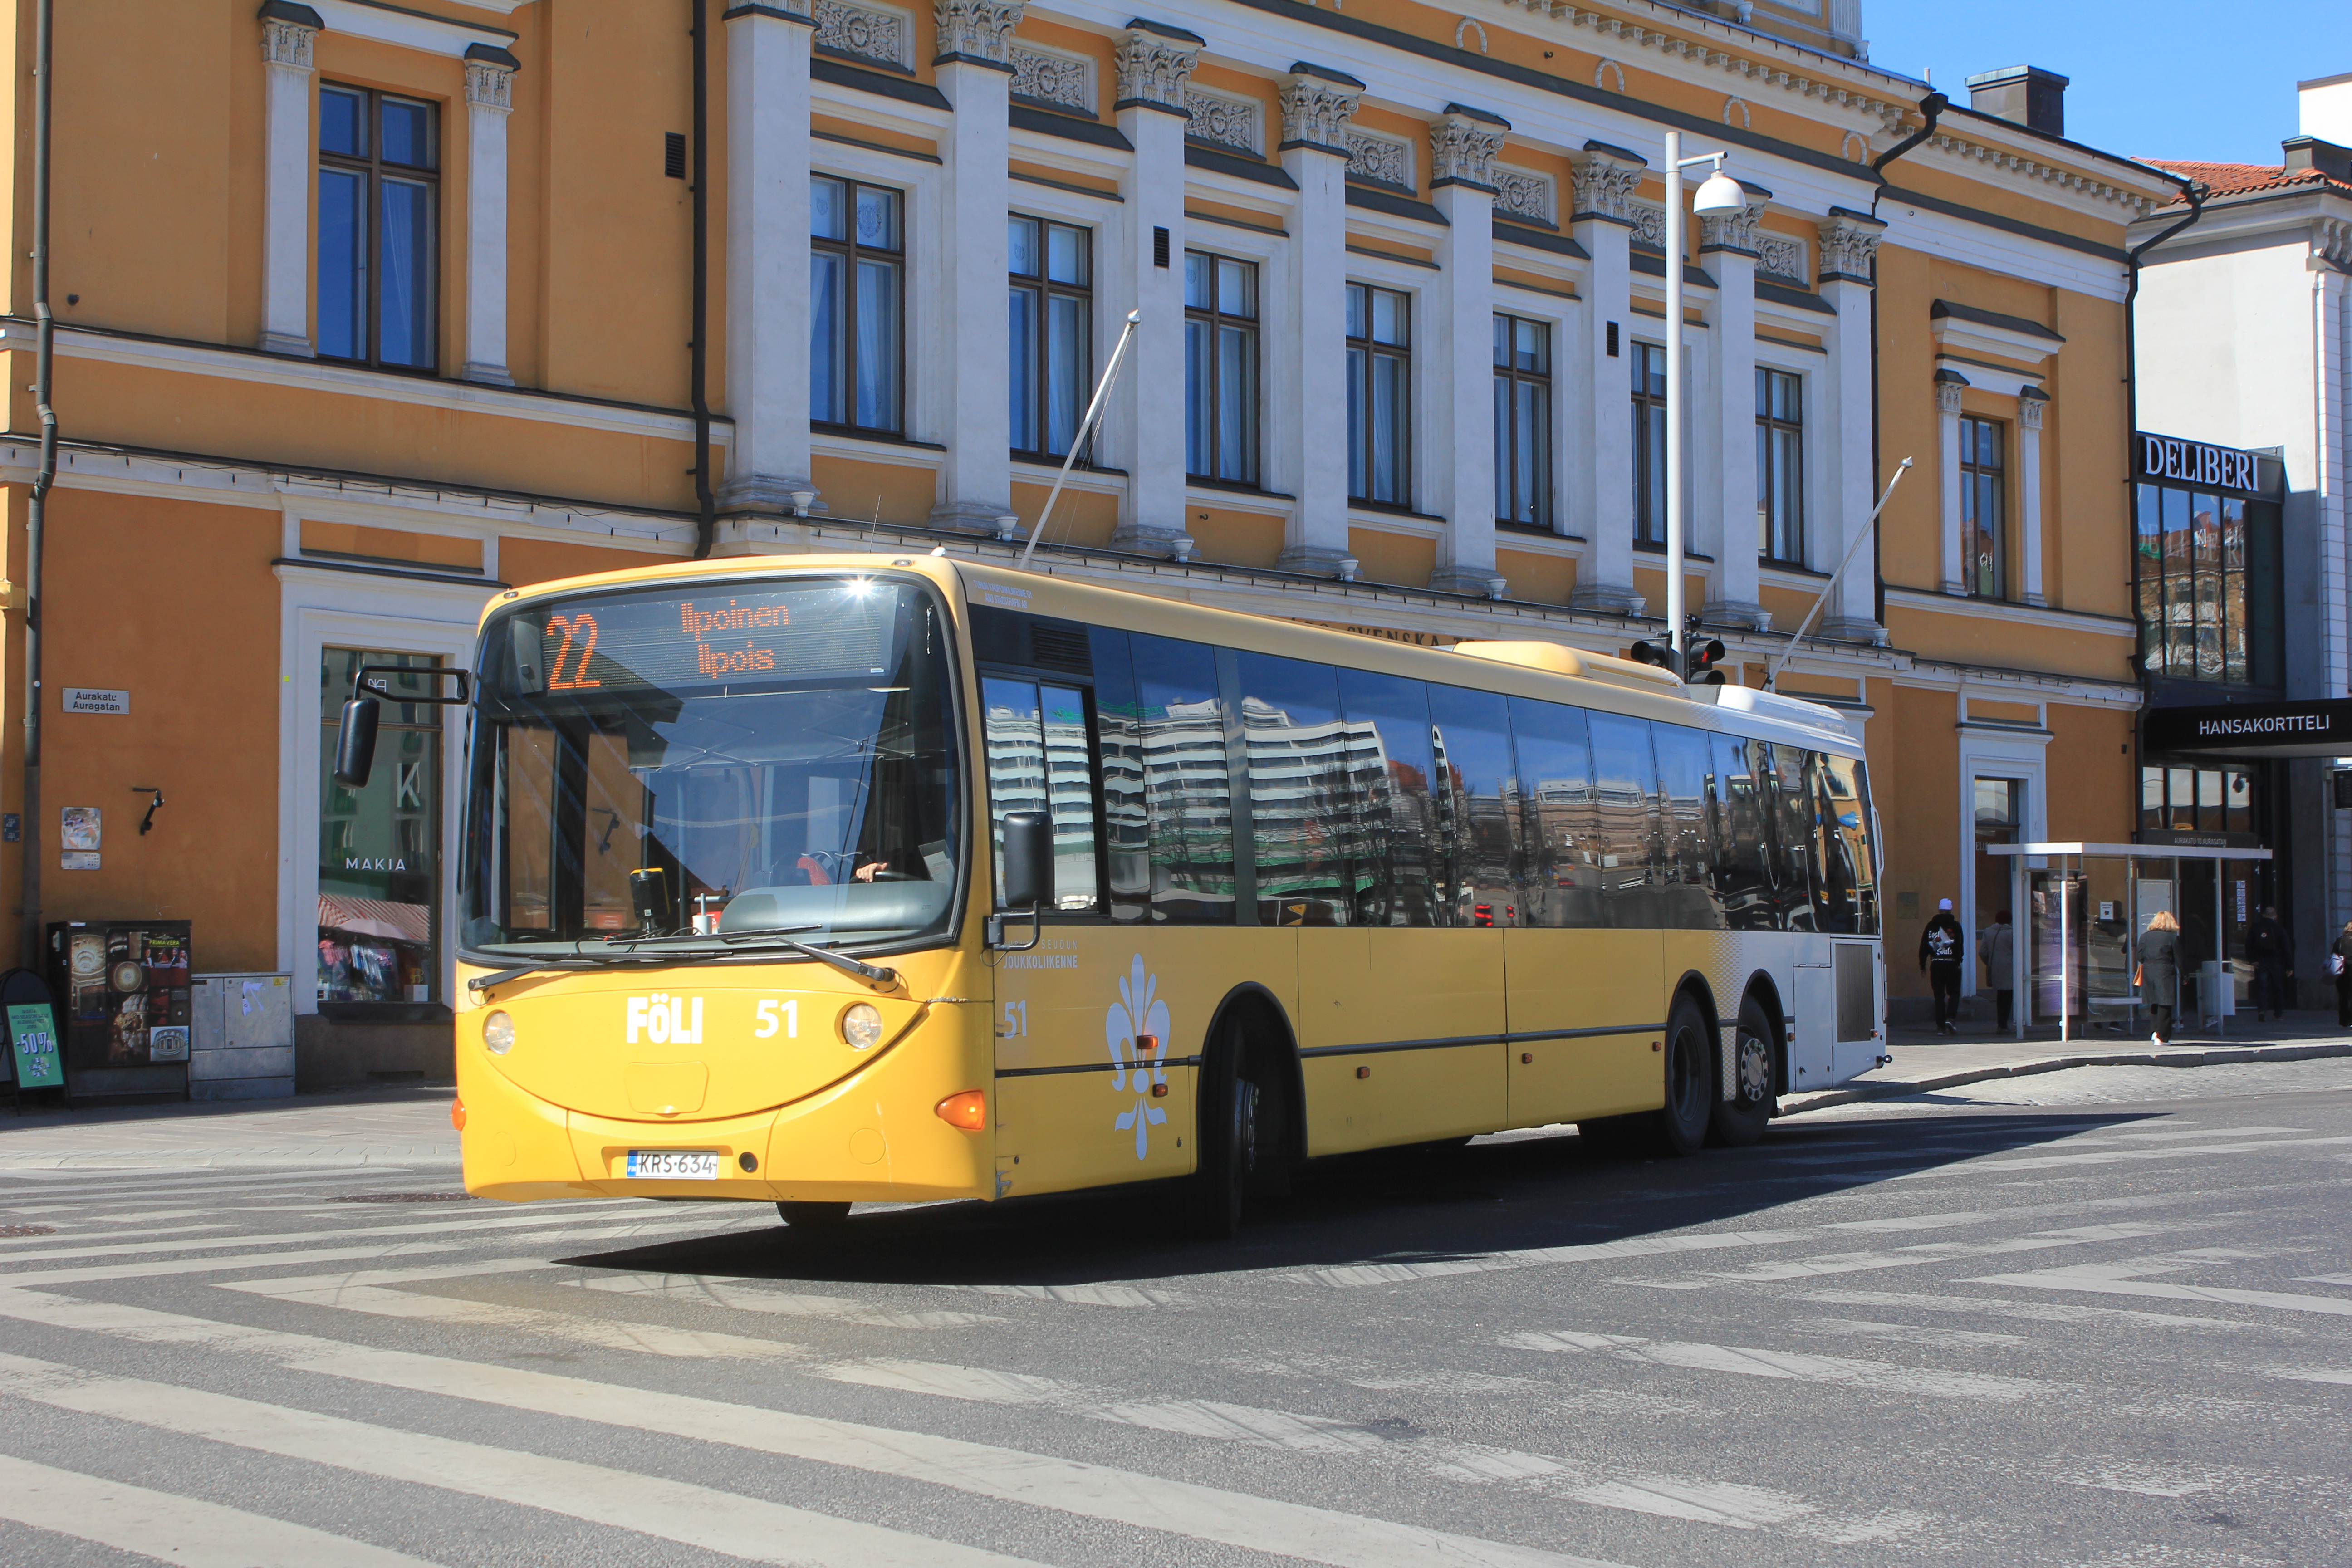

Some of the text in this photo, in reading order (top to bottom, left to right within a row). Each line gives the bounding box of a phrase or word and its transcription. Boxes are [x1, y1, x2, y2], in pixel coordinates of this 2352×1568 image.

[2145, 436, 2259, 492] DELIBERI
[1022, 599, 1028, 609] AB
[680, 599, 790, 641] Ilpoinen
[546, 613, 601, 690] 22
[697, 640, 777, 679] Ilpois
[73, 701, 120, 712] Auragatan
[76, 692, 117, 701] Aurakatu
[2200, 715, 2330, 735] HANSAKORTTELI
[397, 762, 421, 808] K
[346, 858, 406, 870] MAKIA
[1041, 939, 1078, 950] SEUDUN
[1003, 955, 1078, 969] JOUKKOLIIKENNE
[626, 993, 798, 1044] FÖLI 51
[1004, 1000, 1028, 1039] 51
[16, 1032, 54, 1054] -50%
[640, 1153, 713, 1174] KRS-634
